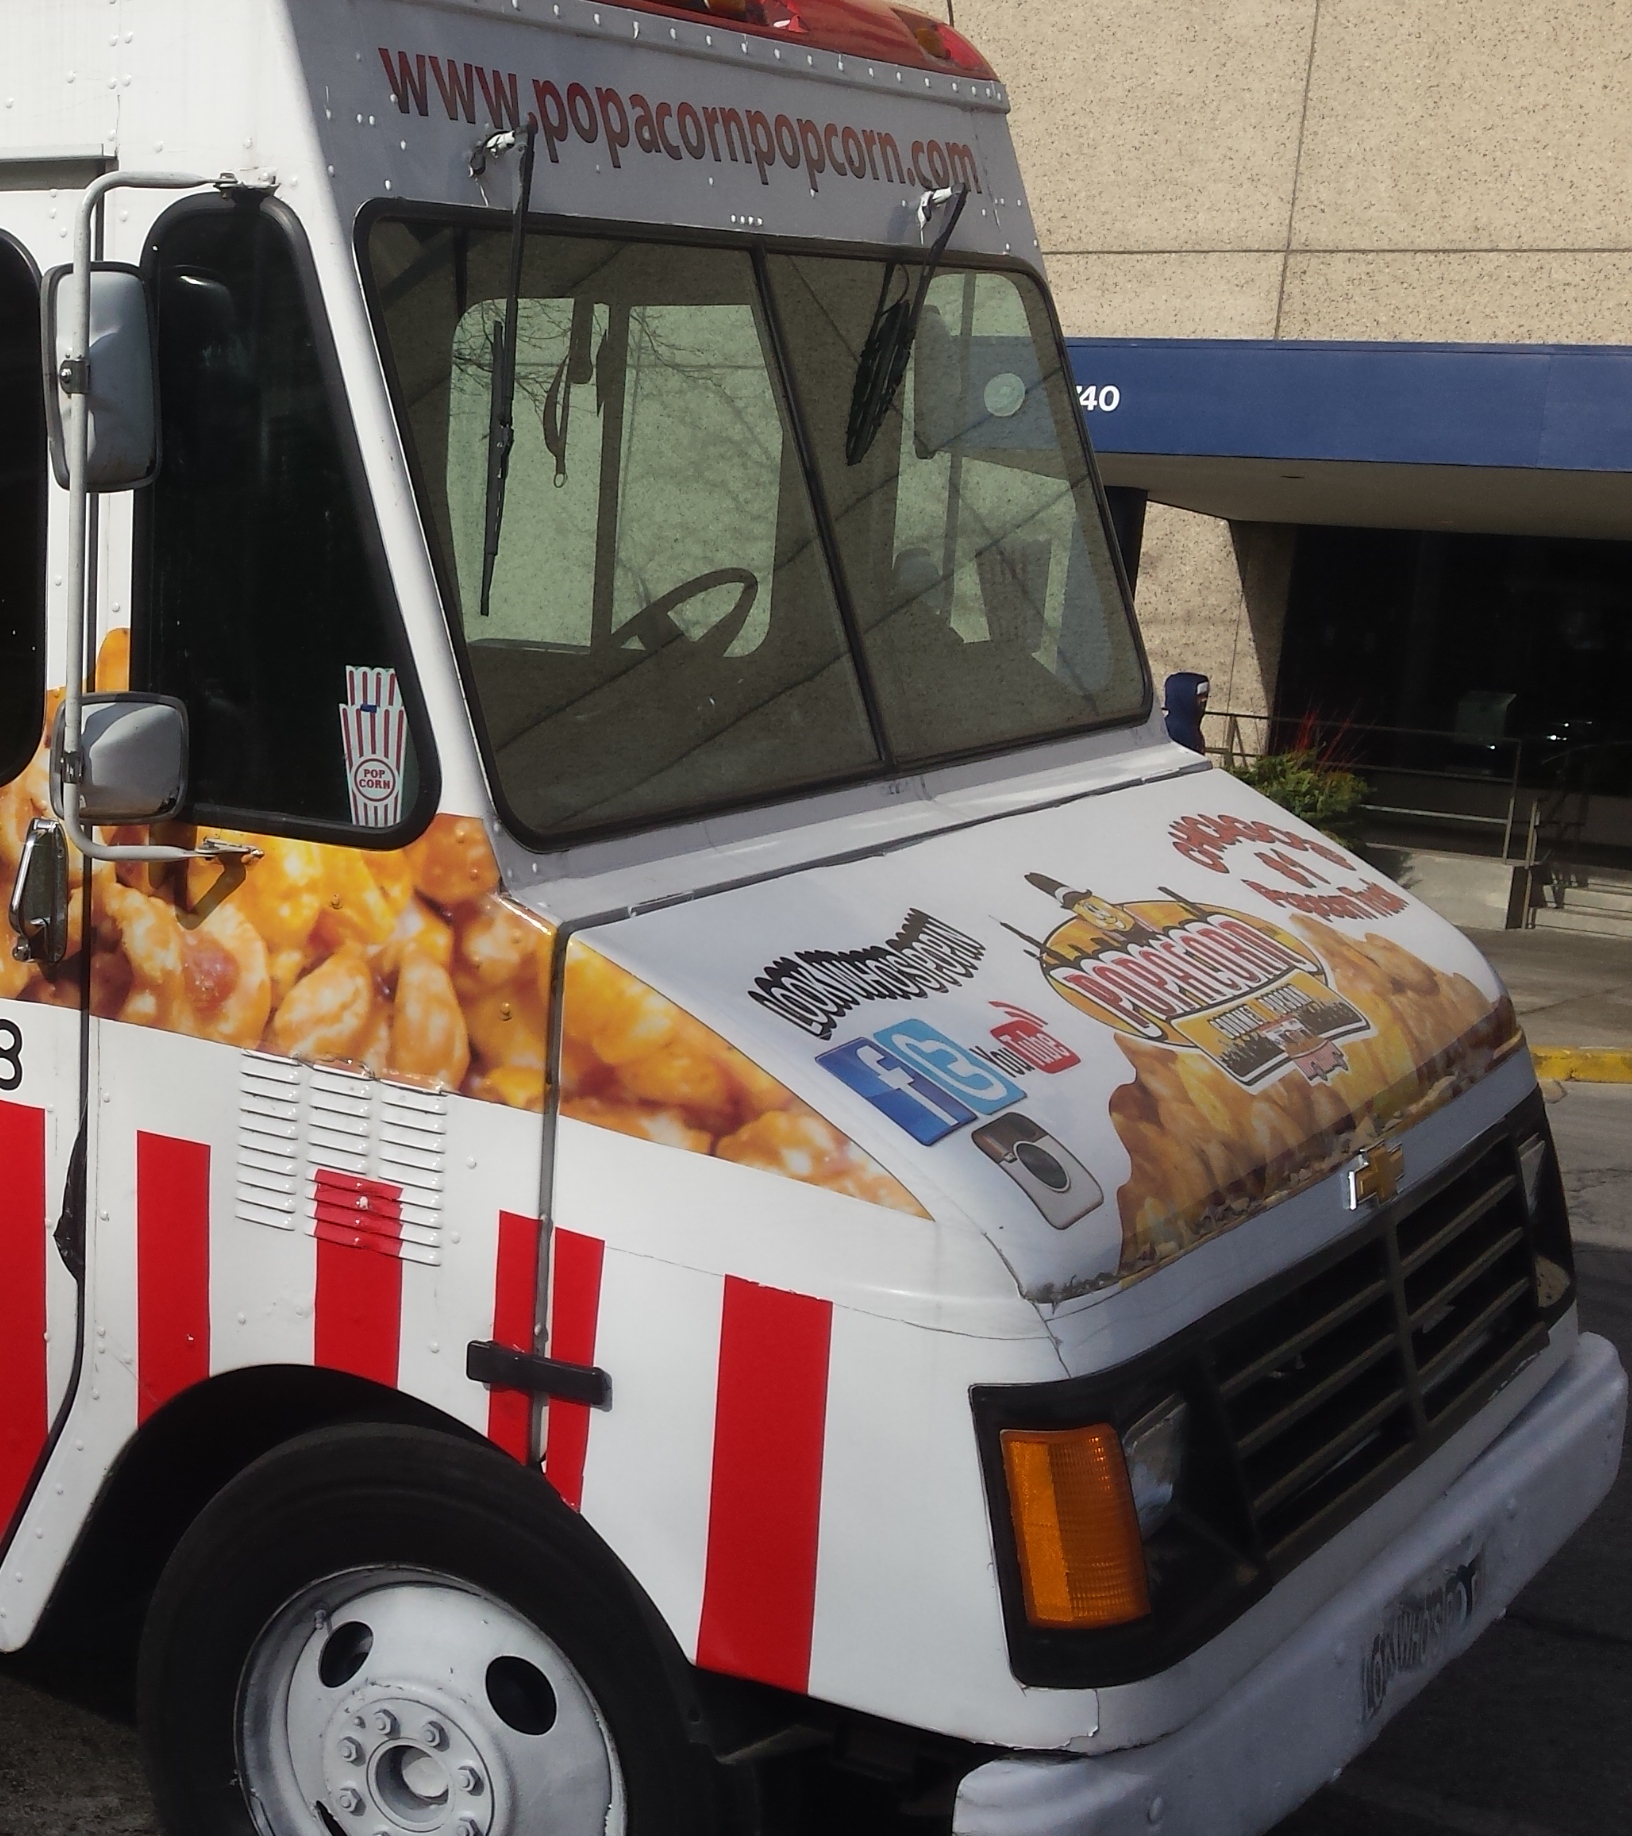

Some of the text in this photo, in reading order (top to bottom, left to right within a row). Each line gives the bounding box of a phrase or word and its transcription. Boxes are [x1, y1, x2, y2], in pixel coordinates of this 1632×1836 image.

[378, 46, 983, 196] www.popacornpopcorn.com
[359, 779, 390, 790] CORN
[363, 768, 386, 779] POP
[746, 956, 859, 1040] LOOK
[1063, 919, 1308, 1028] POPACORN
